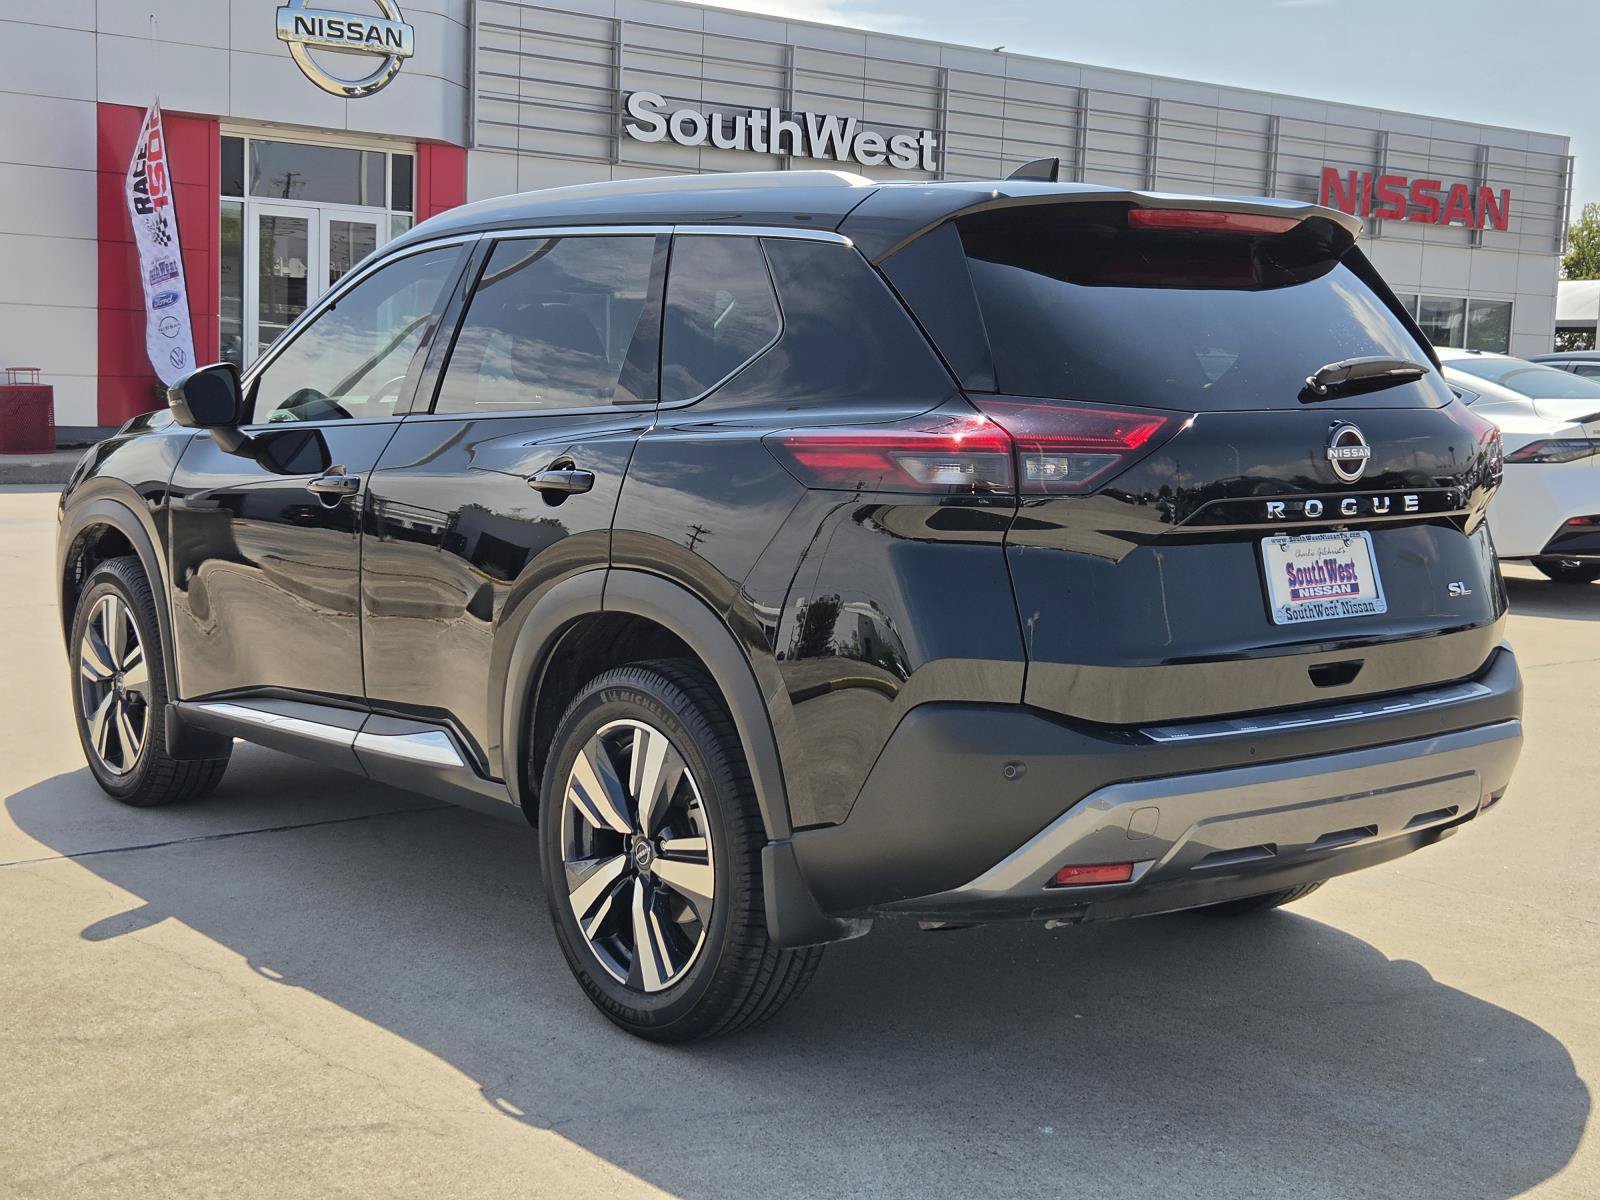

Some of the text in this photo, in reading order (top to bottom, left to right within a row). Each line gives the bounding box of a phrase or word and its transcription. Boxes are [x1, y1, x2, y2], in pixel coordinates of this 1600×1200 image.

[294, 16, 403, 48] NISSAN
[625, 91, 937, 171] SouthWest
[133, 143, 153, 215] RACE
[1320, 166, 1511, 231] NISSAN
[1329, 448, 1370, 458] NISSAN
[1266, 494, 1419, 519] ROGUE
[1285, 557, 1358, 588] SouthWest
[1298, 584, 1352, 599] NISSAN
[1448, 581, 1472, 597] SL
[1285, 600, 1375, 621] SouthWest Nissan
[621, 691, 681, 733] MICHELIN
